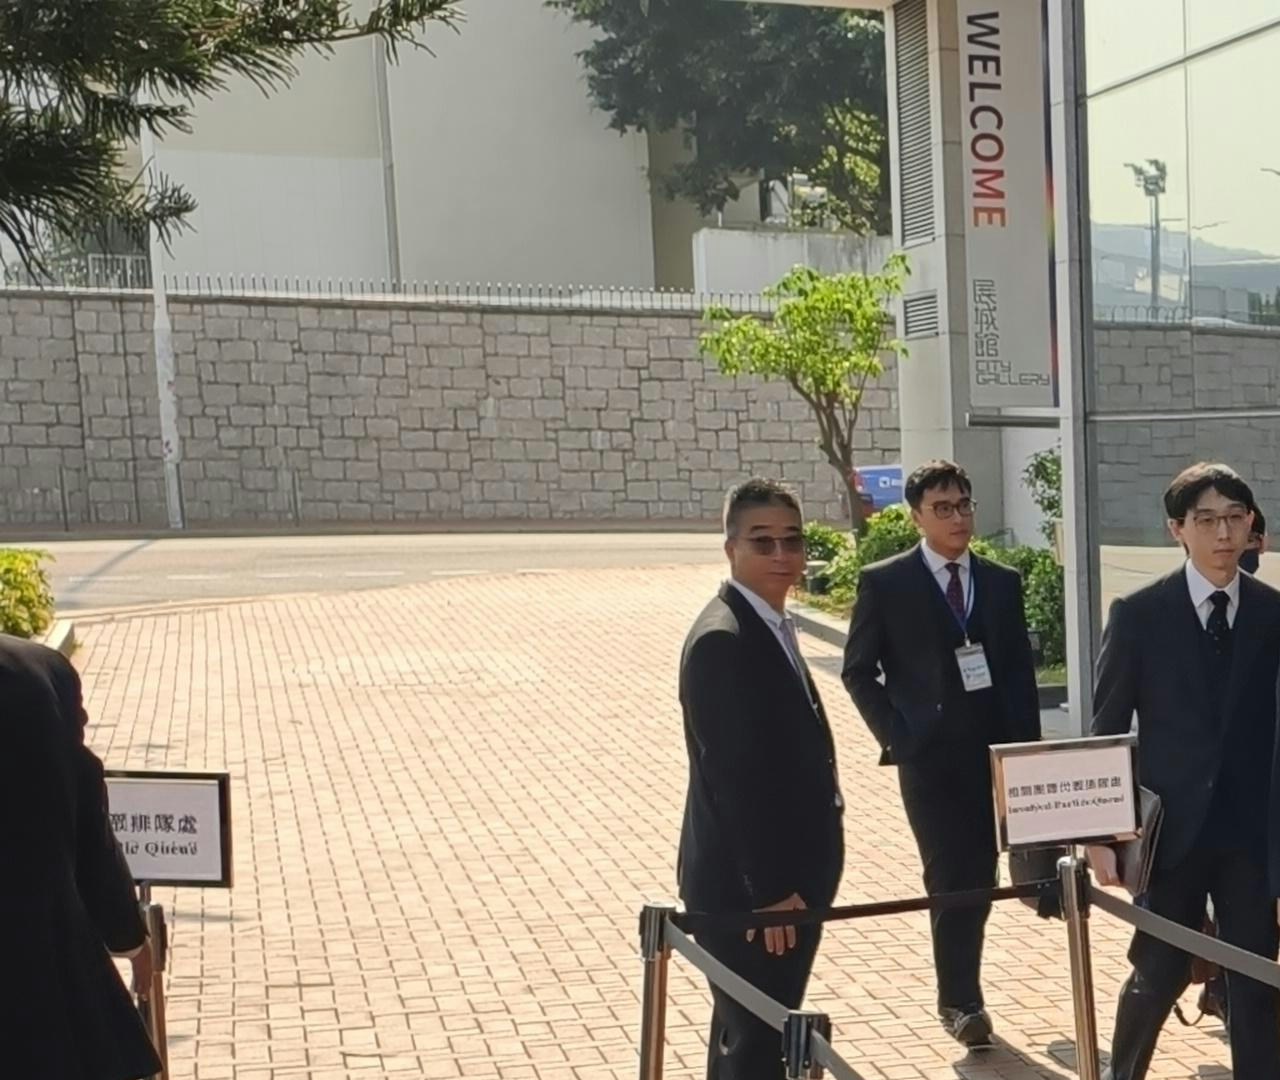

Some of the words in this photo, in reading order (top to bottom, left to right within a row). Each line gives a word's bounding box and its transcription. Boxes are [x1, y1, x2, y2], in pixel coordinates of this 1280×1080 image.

[966, 11, 1007, 228] WELCOME
[973, 279, 1000, 357] 展城館
[975, 359, 1011, 373] CITY
[975, 372, 1050, 386] GALLERY
